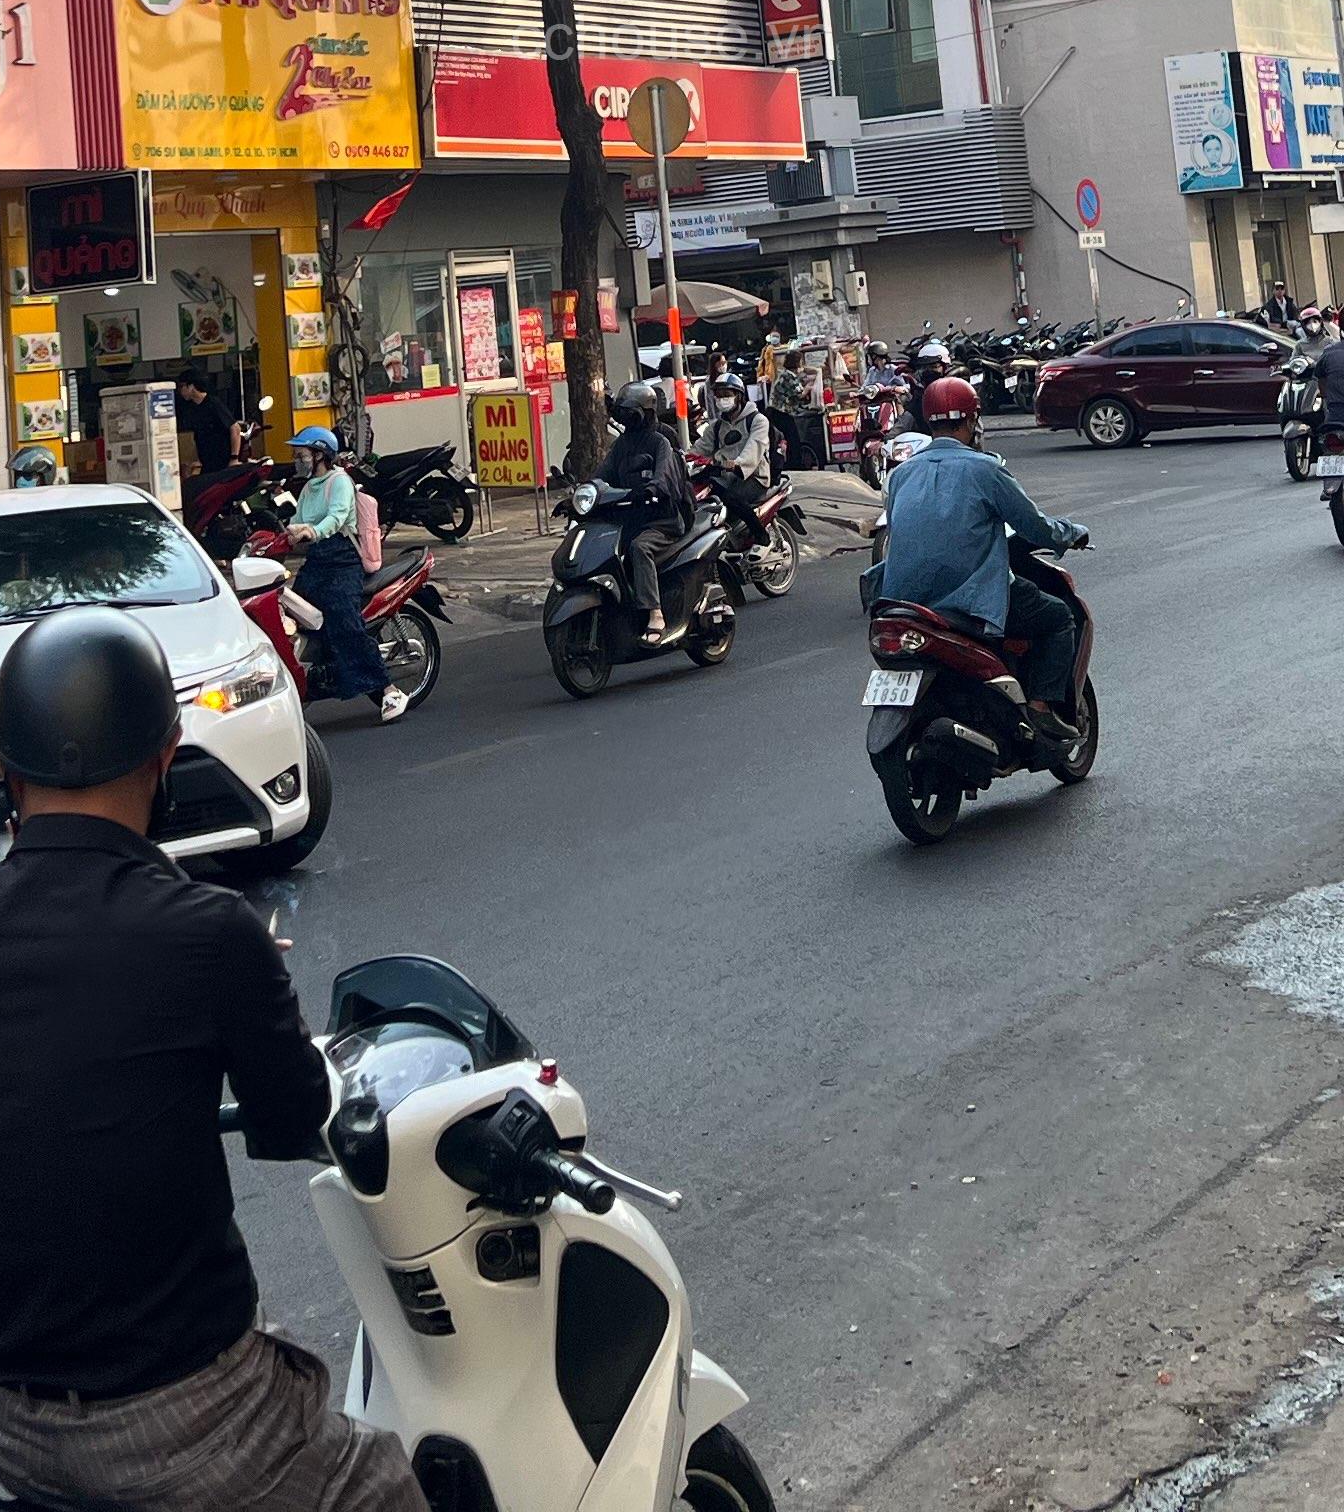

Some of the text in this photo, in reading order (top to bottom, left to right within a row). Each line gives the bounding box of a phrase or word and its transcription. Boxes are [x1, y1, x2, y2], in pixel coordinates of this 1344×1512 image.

[345, 145, 410, 158] 0909 446 827
[485, 399, 517, 427] MÌ
[478, 431, 530, 462] QUẢNG
[480, 469, 489, 483] 2
[871, 688, 909, 703] 1850
